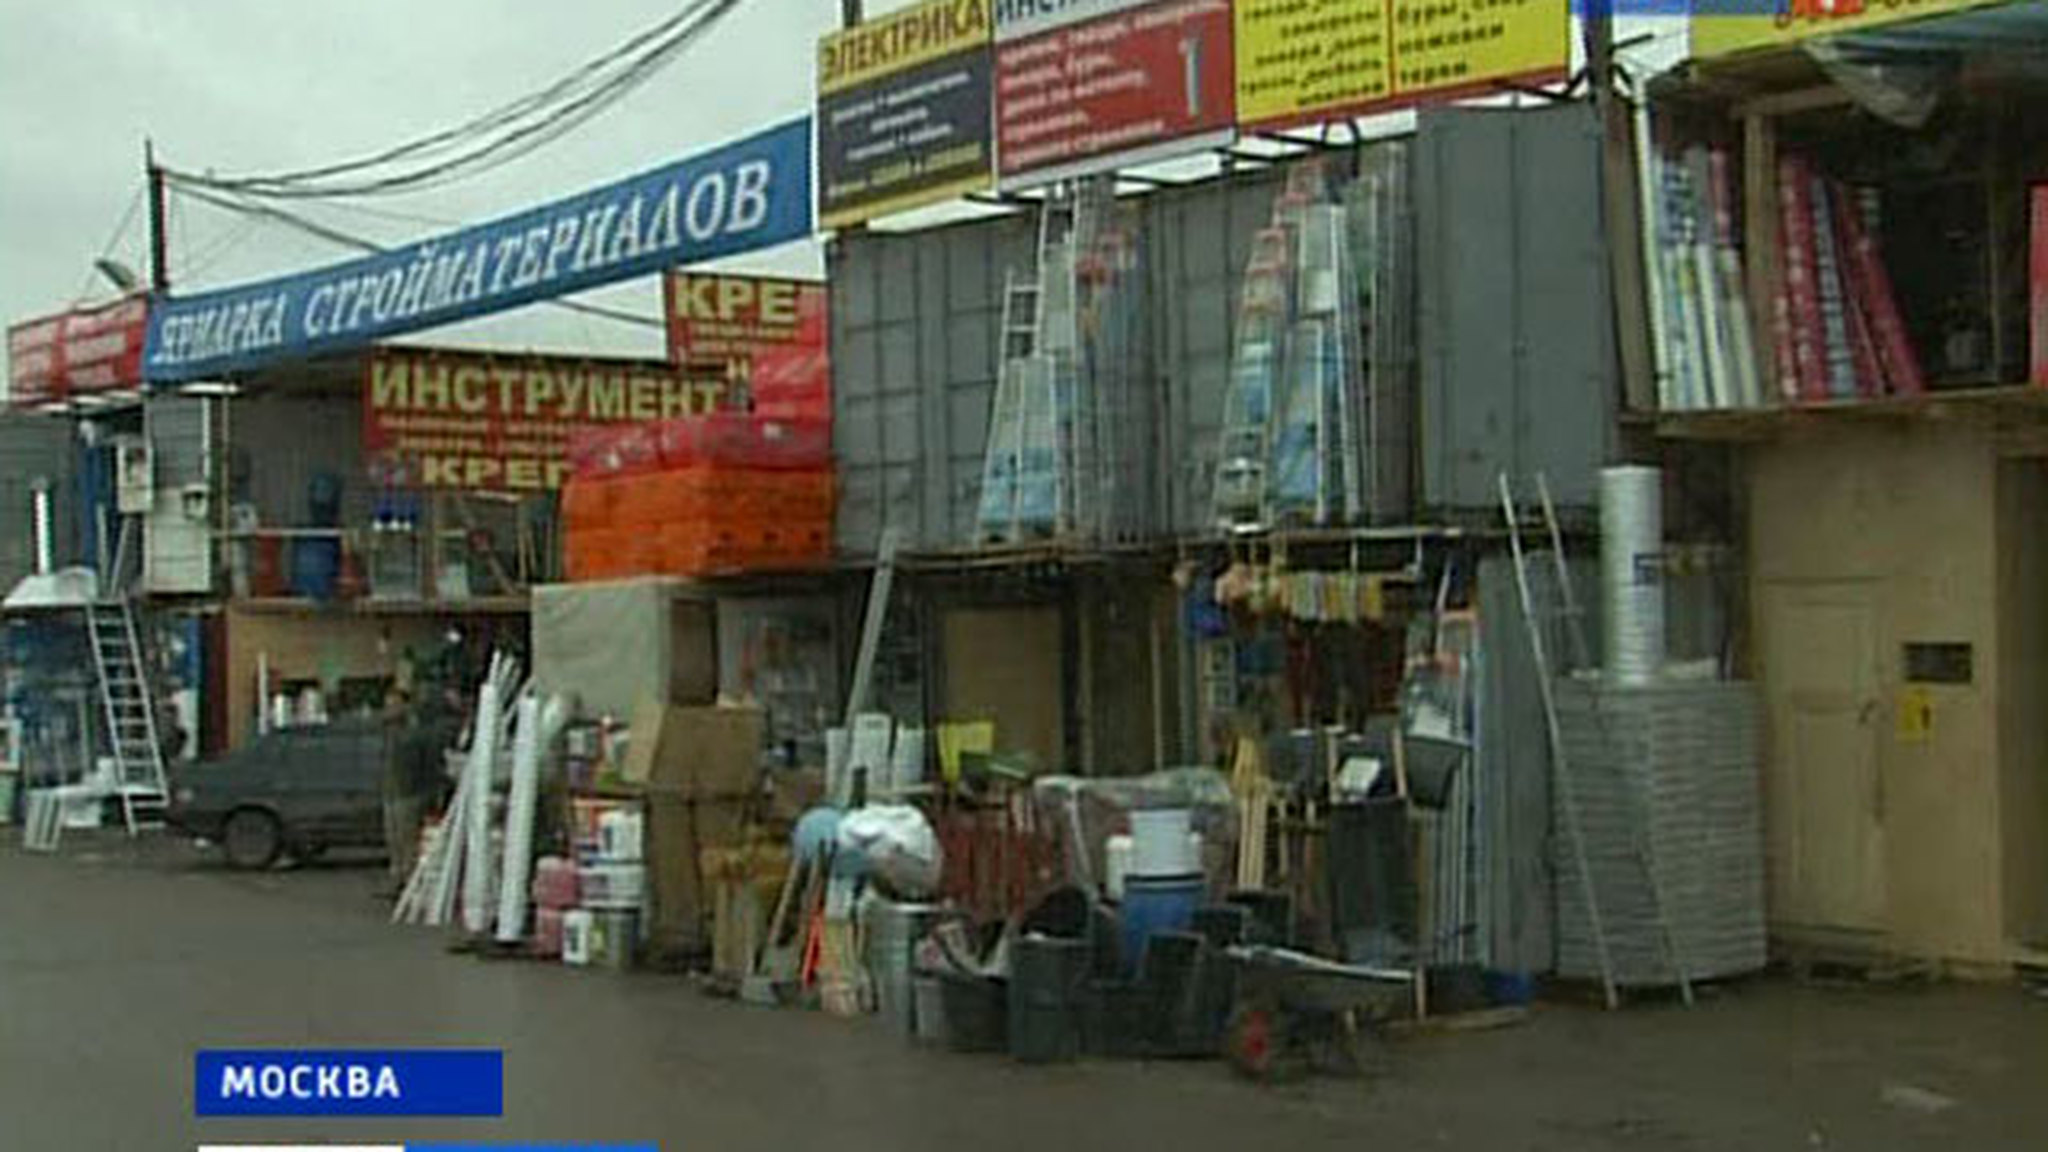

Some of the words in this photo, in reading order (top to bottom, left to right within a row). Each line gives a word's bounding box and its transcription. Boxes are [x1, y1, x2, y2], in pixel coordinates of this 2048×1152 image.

[822, 0, 985, 84] ЭЛЕКТРИКА
[152, 292, 288, 364] ЯРМАРКА
[304, 159, 771, 338] СТРОЙМАТЕРИАЛОВ
[373, 360, 726, 419] ИНСТРУМЕНТ
